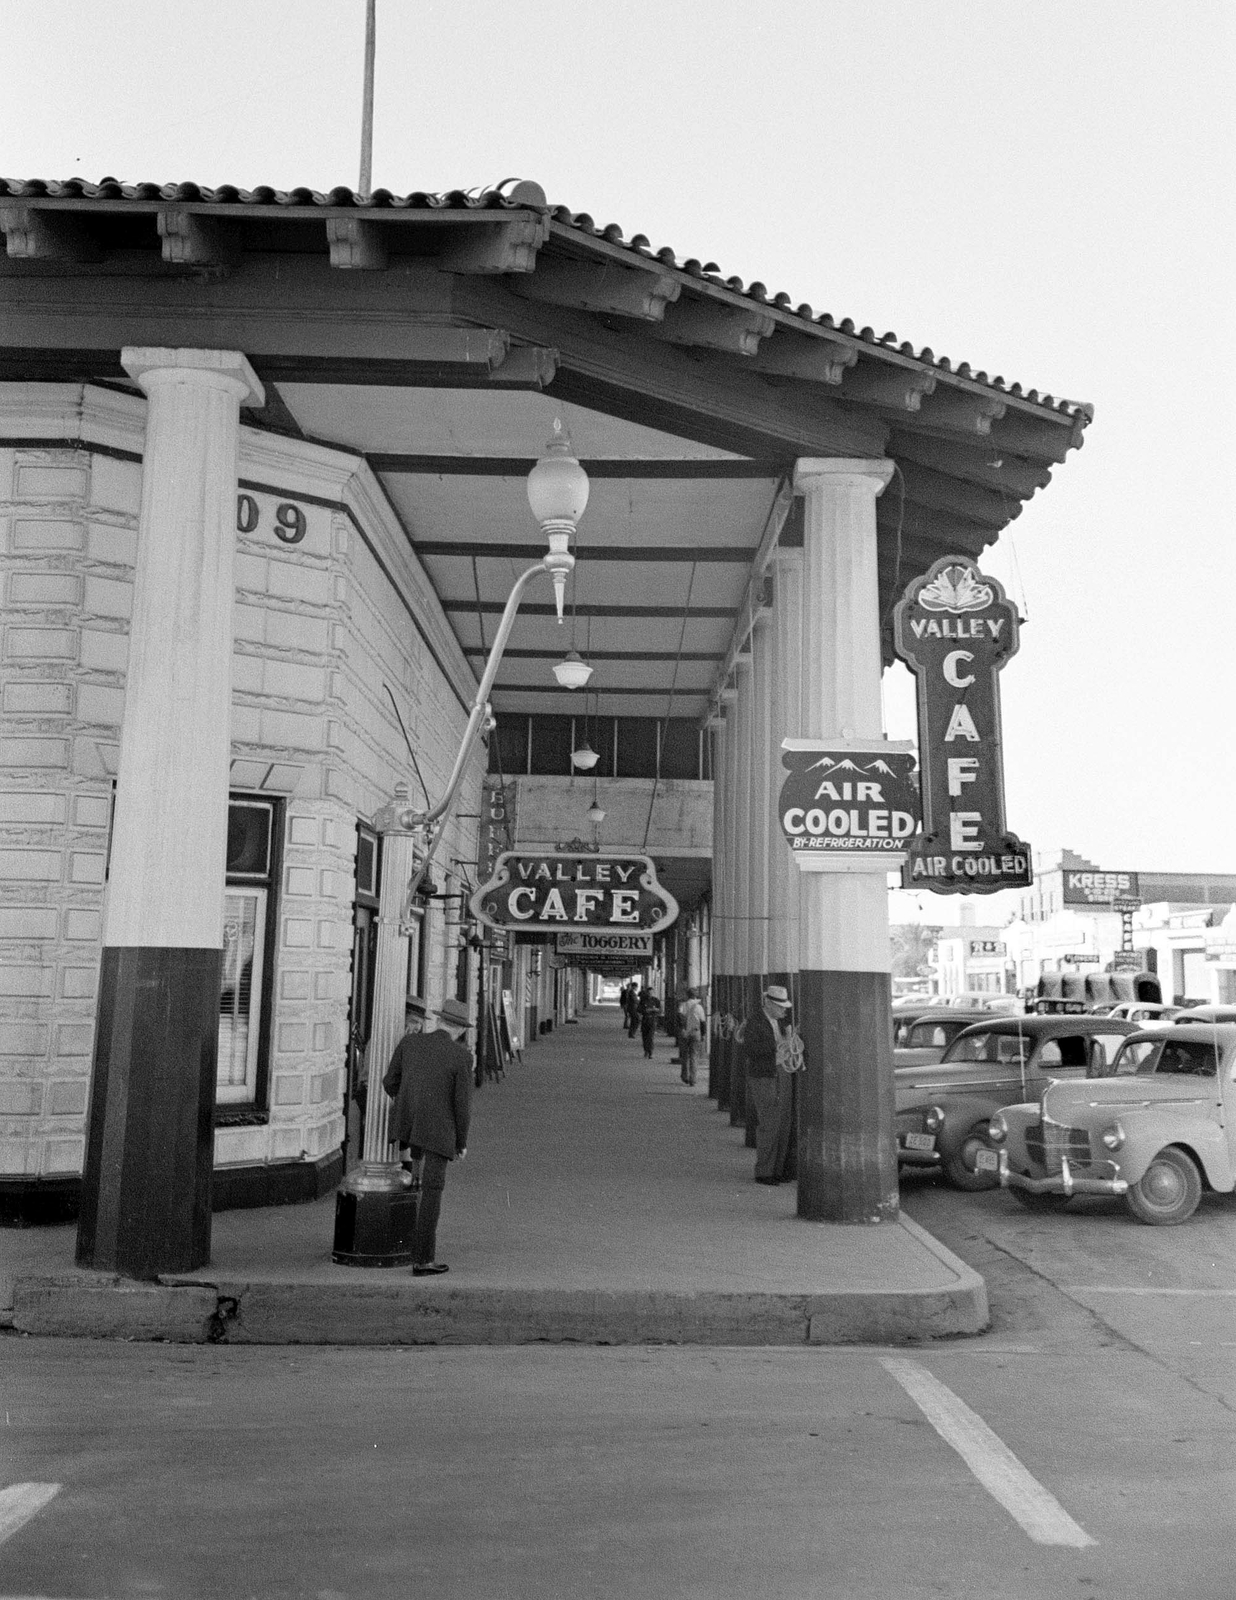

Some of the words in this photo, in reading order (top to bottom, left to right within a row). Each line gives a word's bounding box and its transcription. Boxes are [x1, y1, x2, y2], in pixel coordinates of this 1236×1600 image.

[910, 618, 1005, 639] VALLEY
[943, 650, 985, 851] CAFE
[814, 781, 885, 803] AIR
[783, 807, 915, 838] COOLED
[793, 837, 905, 850] BY-REFRIGERATION
[518, 862, 636, 883] VALLEY
[913, 857, 947, 877] AIR
[952, 855, 1027, 876] COOLED
[1068, 872, 1131, 889] KRESS
[508, 887, 641, 923] CAFE
[580, 934, 650, 949] TOGGERY
